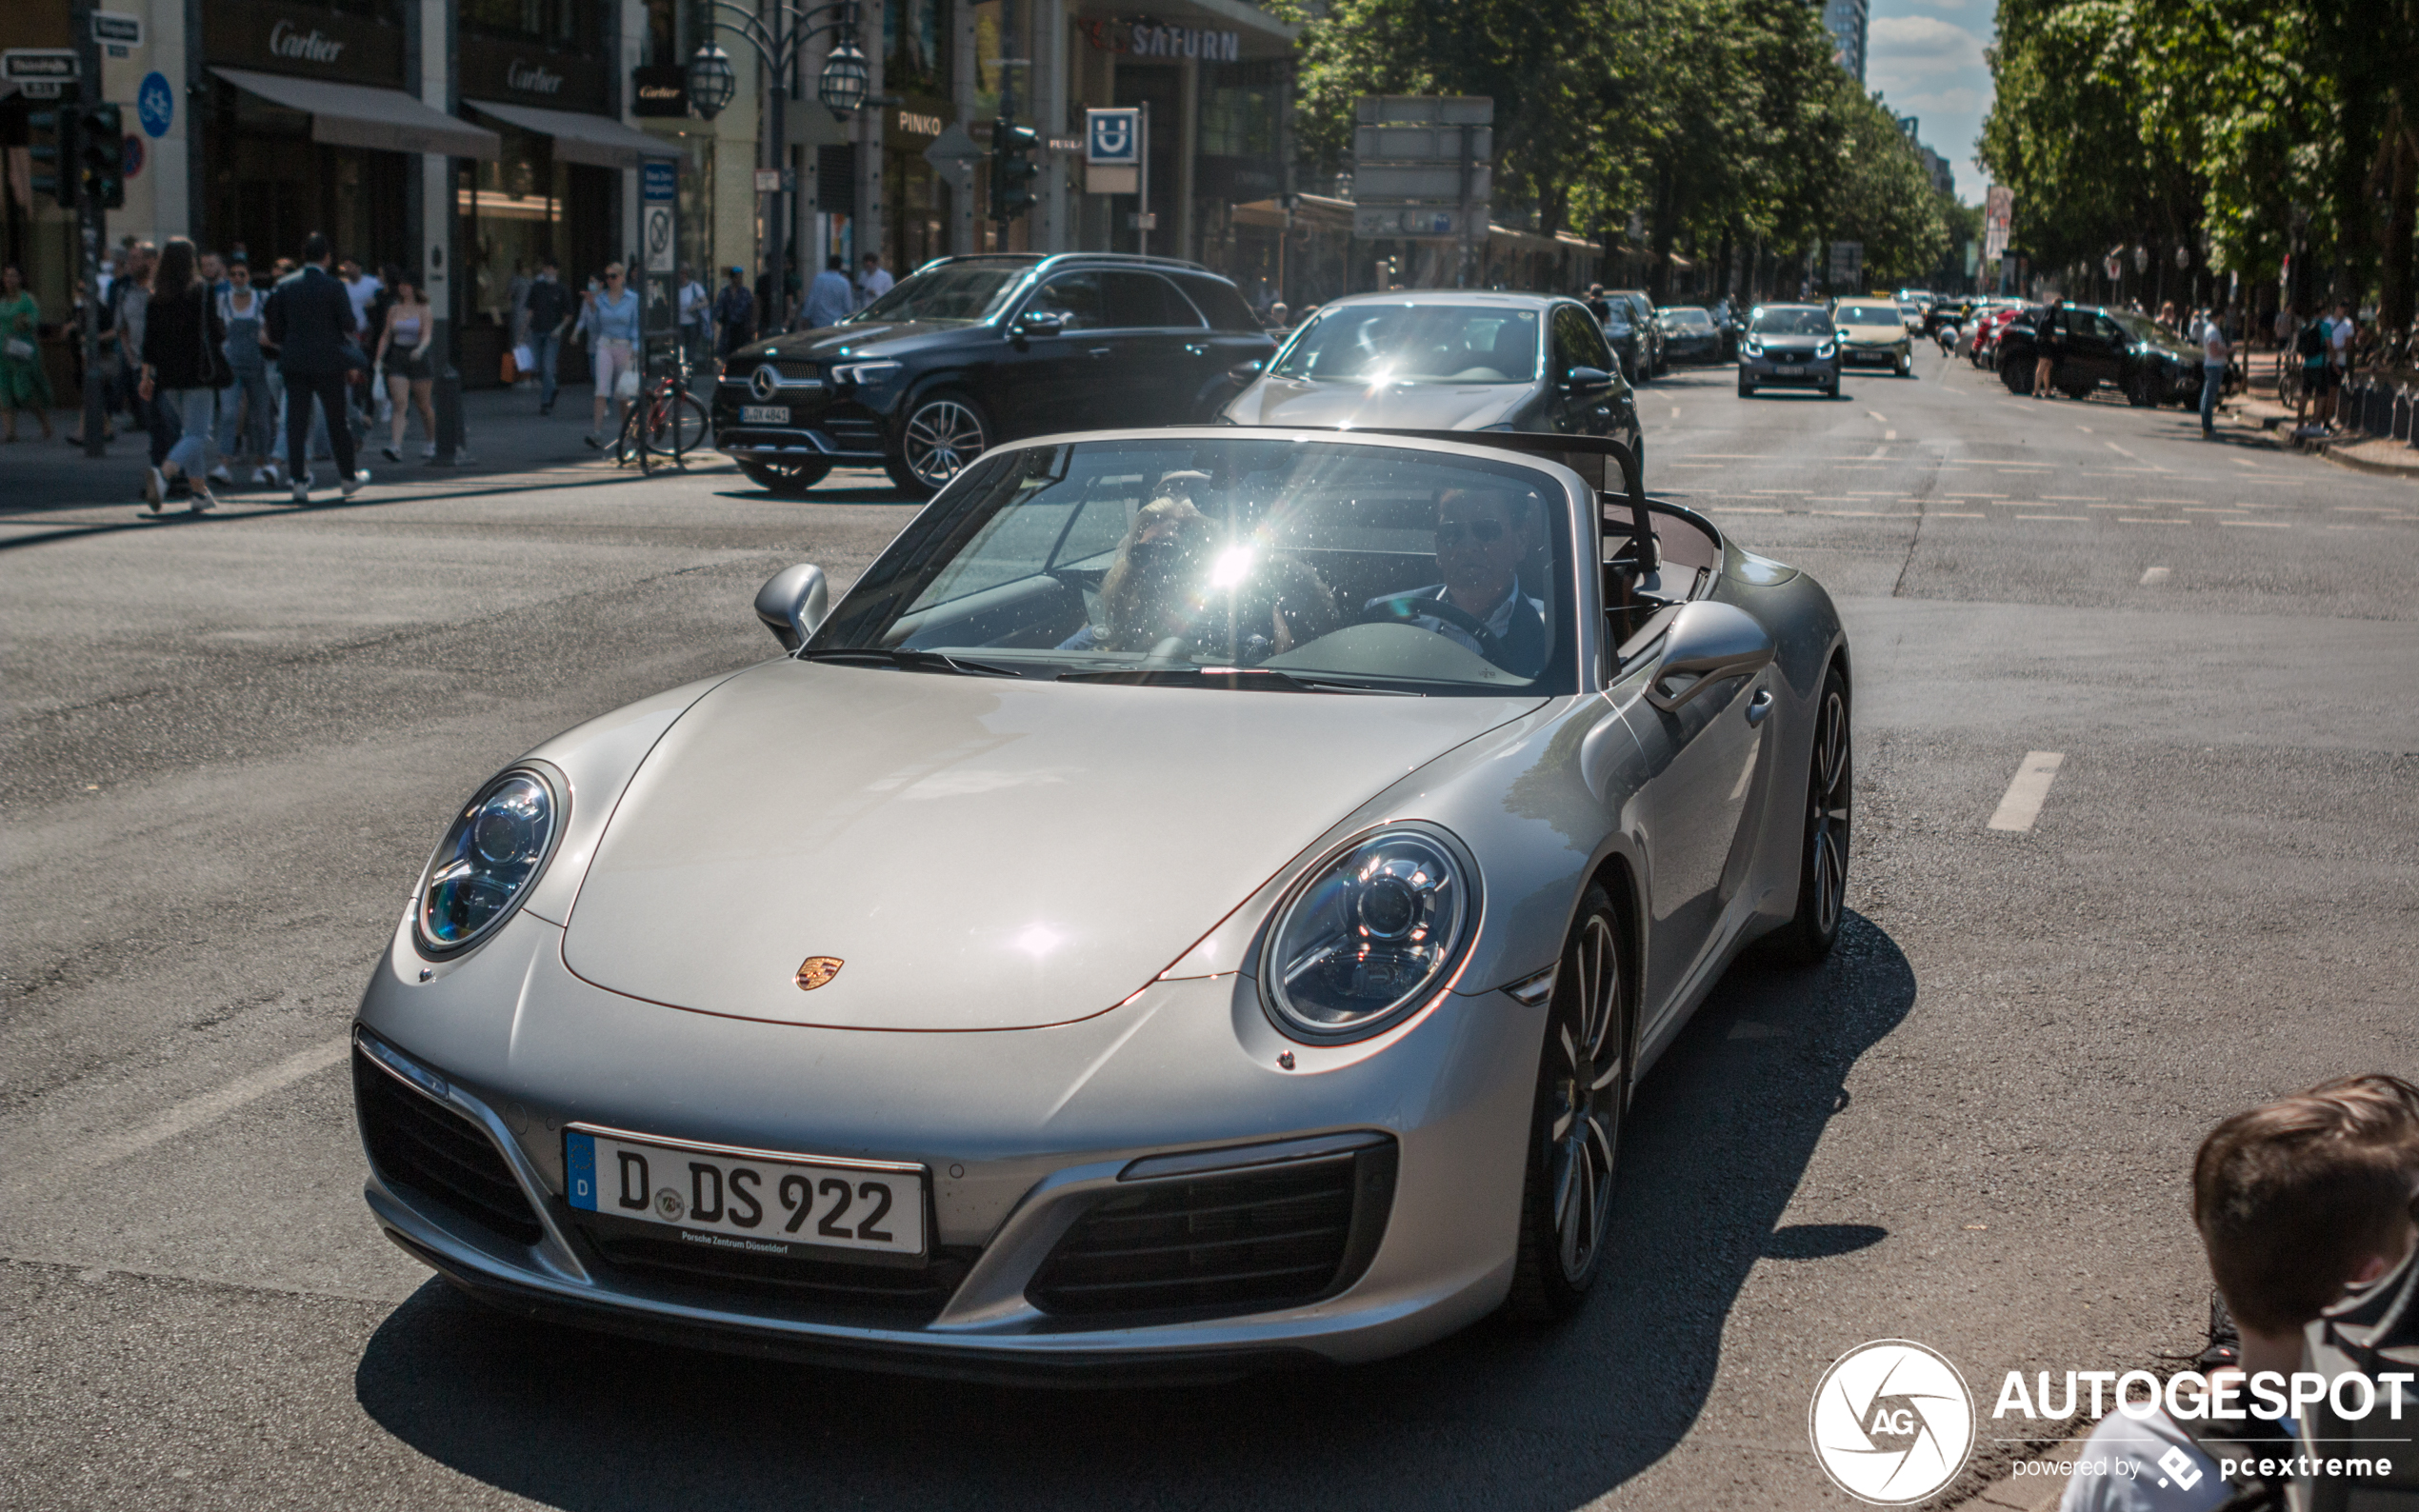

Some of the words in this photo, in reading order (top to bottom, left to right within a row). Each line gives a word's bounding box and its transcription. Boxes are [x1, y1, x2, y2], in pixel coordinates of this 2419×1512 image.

[270, 20, 344, 64] Cartier
[1132, 24, 1238, 62] SATURN
[507, 57, 563, 94] Cartier
[638, 85, 680, 99] Cartier
[899, 110, 942, 136] PINKO
[1049, 139, 1084, 149] FURLA
[765, 408, 788, 421] 4841
[577, 1179, 589, 1197] D
[616, 1150, 650, 1211] D
[689, 1161, 764, 1229] DS
[779, 1174, 893, 1243] 922
[682, 1230, 712, 1245] Porsche
[712, 1236, 745, 1249] Zentrum
[746, 1240, 789, 1254] Düsseldorf
